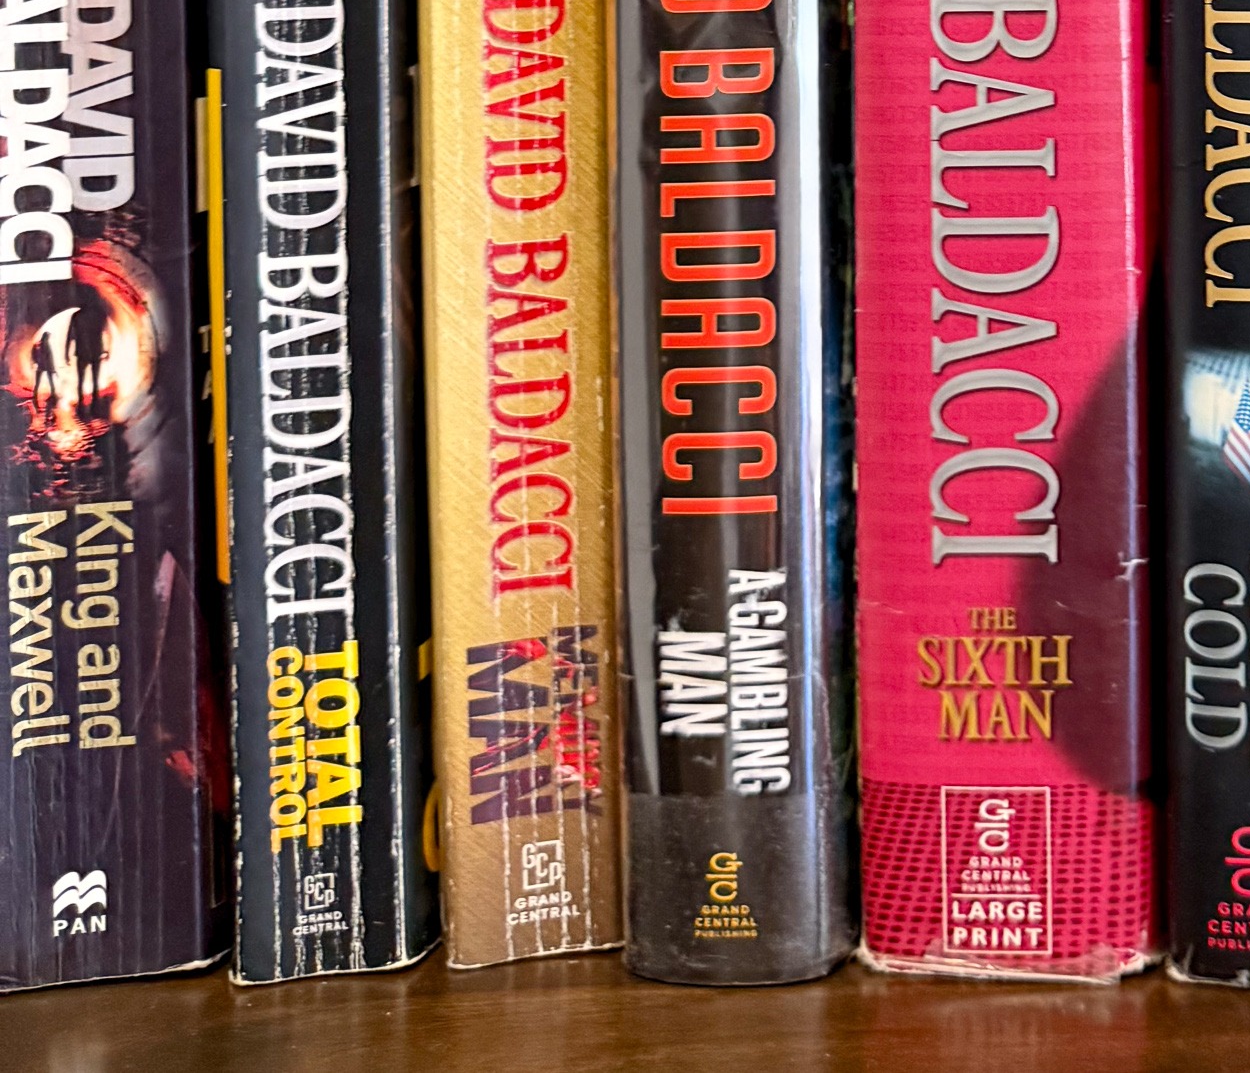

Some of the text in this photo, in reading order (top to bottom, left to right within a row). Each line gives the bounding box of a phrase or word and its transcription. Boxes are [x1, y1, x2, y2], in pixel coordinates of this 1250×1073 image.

[660, 47, 778, 515] BALDACCI
[255, 2, 354, 624] DAVID BALDACCI
[485, 233, 576, 600] BALDACCI
[7, 510, 71, 757] Maxwell
[62, 500, 137, 750] King and
[968, 607, 1017, 630] THE
[728, 567, 791, 797] A GAMBLING
[917, 635, 1073, 686] SIXTH
[1183, 562, 1248, 751] COLD
[659, 629, 726, 737] MAN
[467, 636, 552, 825] MAN
[939, 690, 1055, 742] MAN
[266, 646, 310, 855] CONTROL
[303, 640, 364, 848] TOTAL
[961, 870, 1030, 882] CENTRAL
[969, 856, 1023, 868] GRAND
[53, 914, 107, 937] PAN
[296, 910, 343, 924] GRAND
[507, 905, 580, 926] CENTRAL
[514, 890, 572, 910] GRAND
[694, 917, 758, 928] CENTRAL
[701, 904, 750, 916] GRAND
[952, 900, 1043, 922] LARGE
[292, 920, 350, 936] CENTRAL
[953, 927, 1043, 948] PRINT
